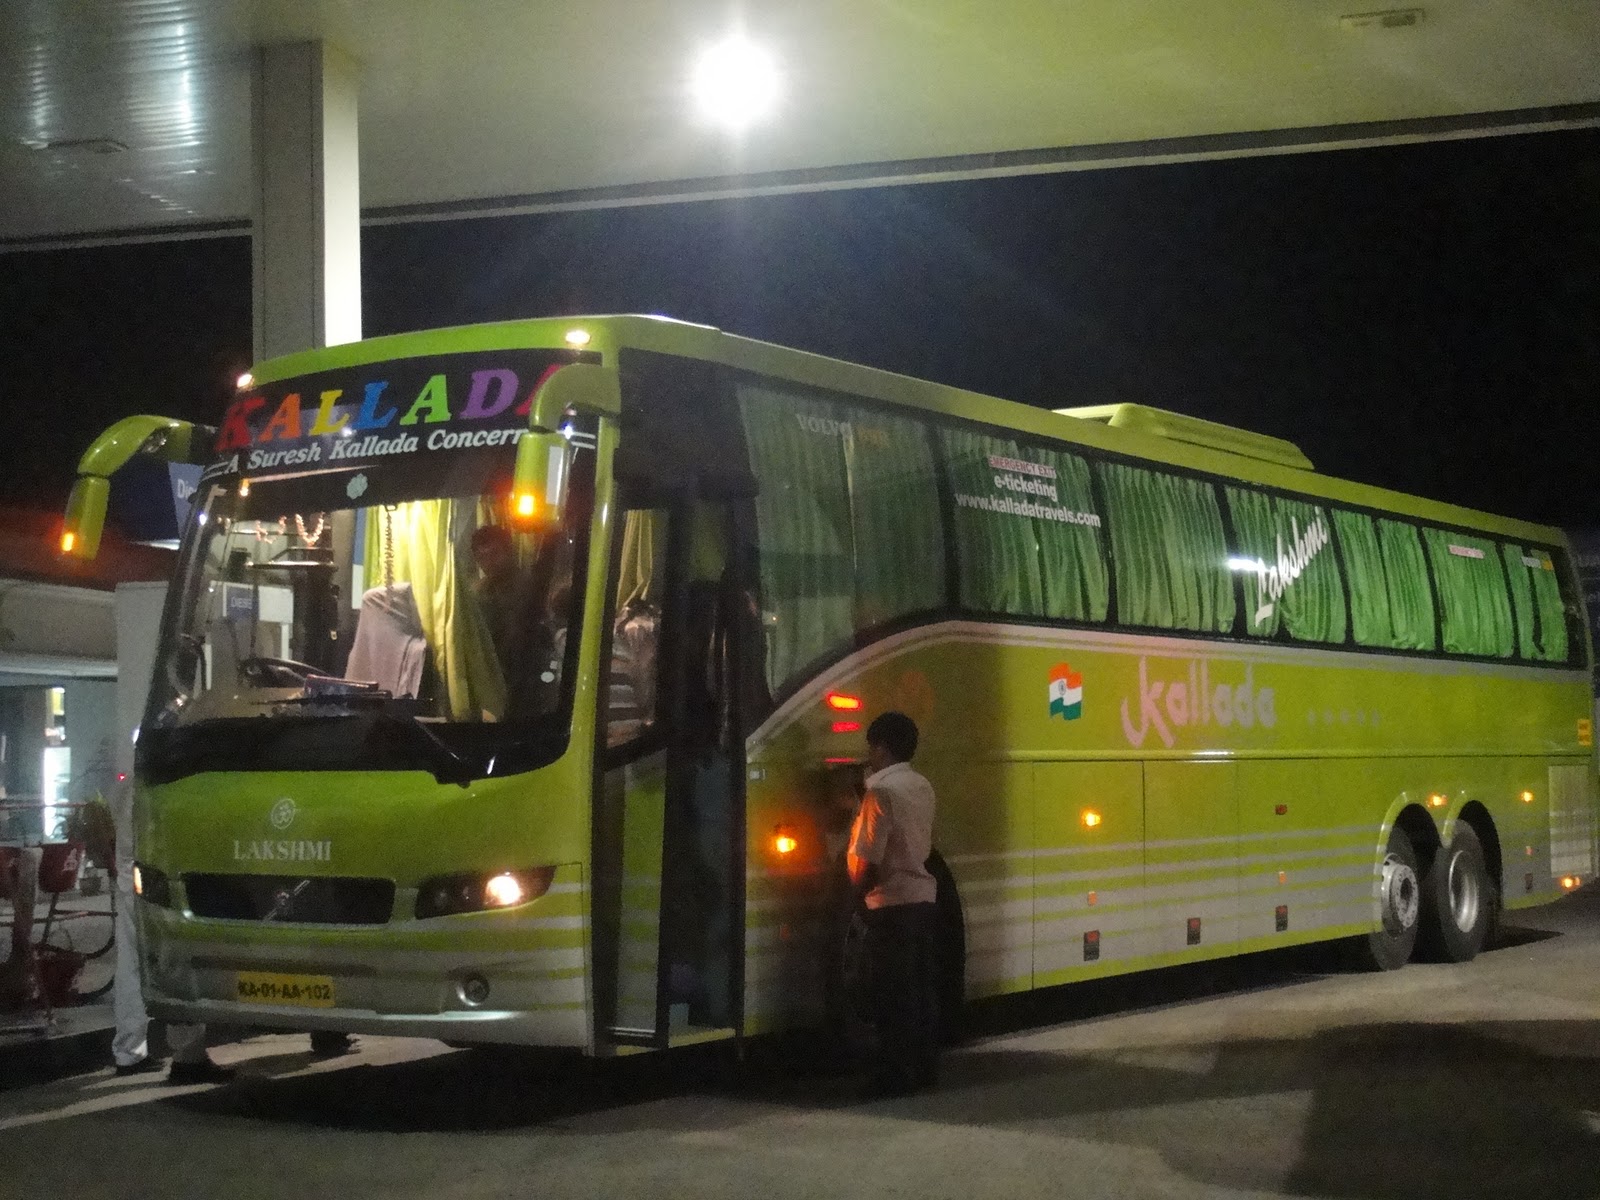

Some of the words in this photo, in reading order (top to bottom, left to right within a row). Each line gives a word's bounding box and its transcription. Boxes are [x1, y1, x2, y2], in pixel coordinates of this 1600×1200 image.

[225, 455, 239, 473] A
[247, 443, 322, 470] Suresh
[329, 432, 419, 461] Kallada
[994, 474, 1057, 502] e-ticketing
[954, 492, 1101, 528] www.kalladatravels.com
[1255, 505, 1328, 628] Lakshmi
[233, 840, 333, 861] LAKSHMI
